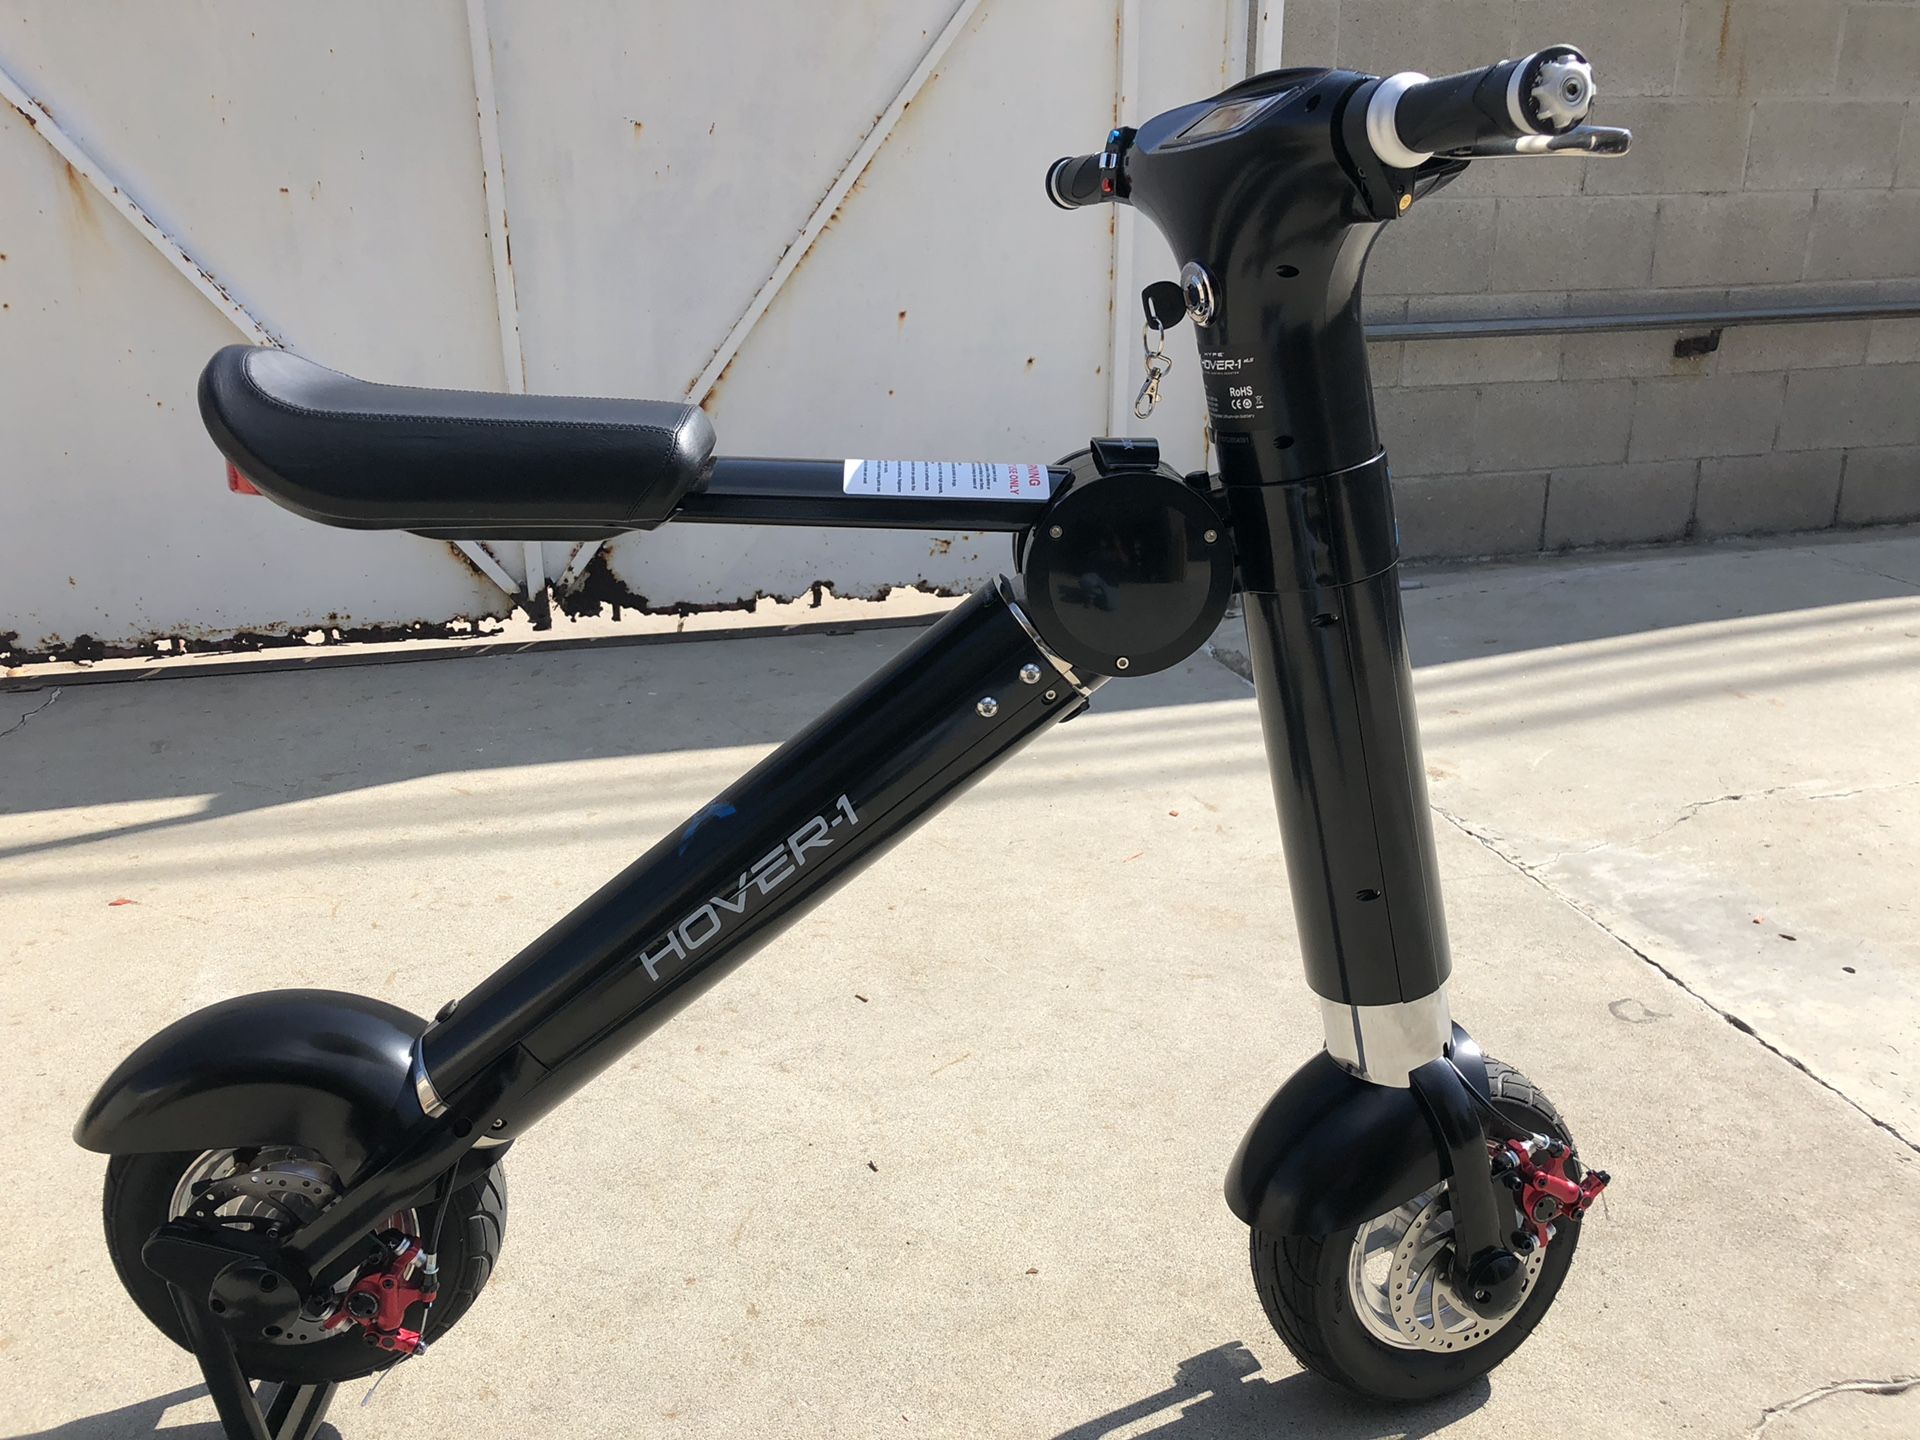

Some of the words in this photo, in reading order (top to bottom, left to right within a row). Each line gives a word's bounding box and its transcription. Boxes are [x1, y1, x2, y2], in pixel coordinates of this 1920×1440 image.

[1229, 386, 1253, 397] RoHS
[1009, 474, 1020, 495] ONLY
[639, 793, 859, 982] HOVER-1
